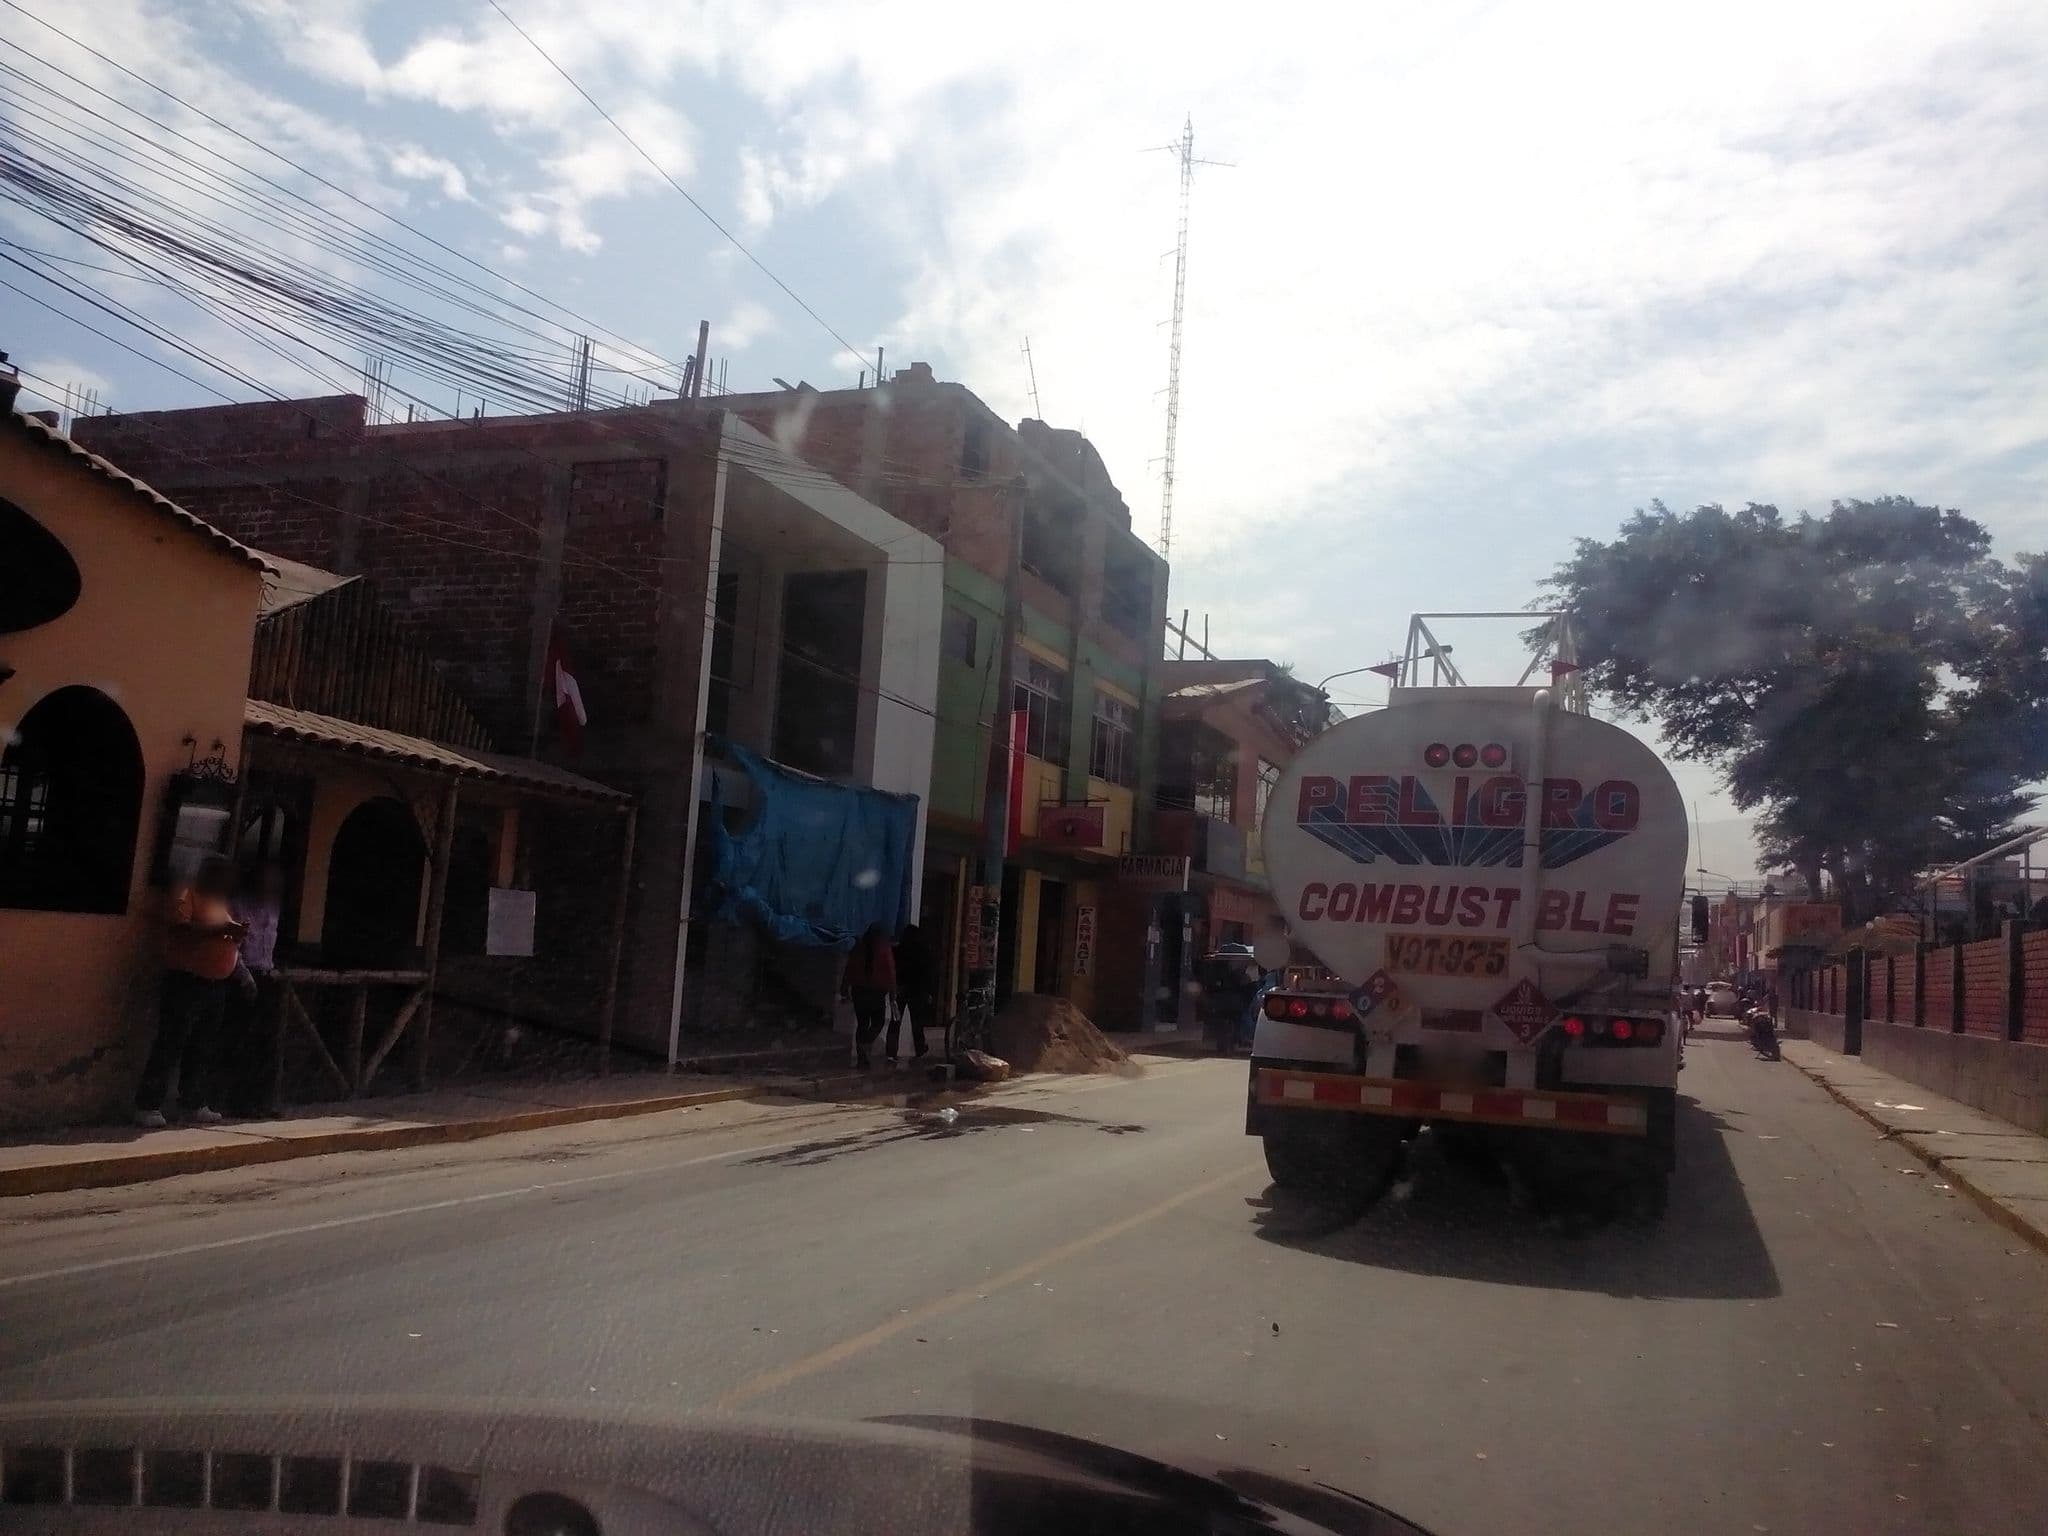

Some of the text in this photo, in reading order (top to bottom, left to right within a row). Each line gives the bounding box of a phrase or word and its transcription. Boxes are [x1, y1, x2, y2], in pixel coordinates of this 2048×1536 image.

[1297, 776, 1641, 832] PELIGRO
[1121, 856, 1184, 878] FARMACIA
[1299, 882, 1642, 937] COMBUSTBLE
[1076, 907, 1093, 975] FARMACIA
[1521, 1024, 1530, 1037] 3
